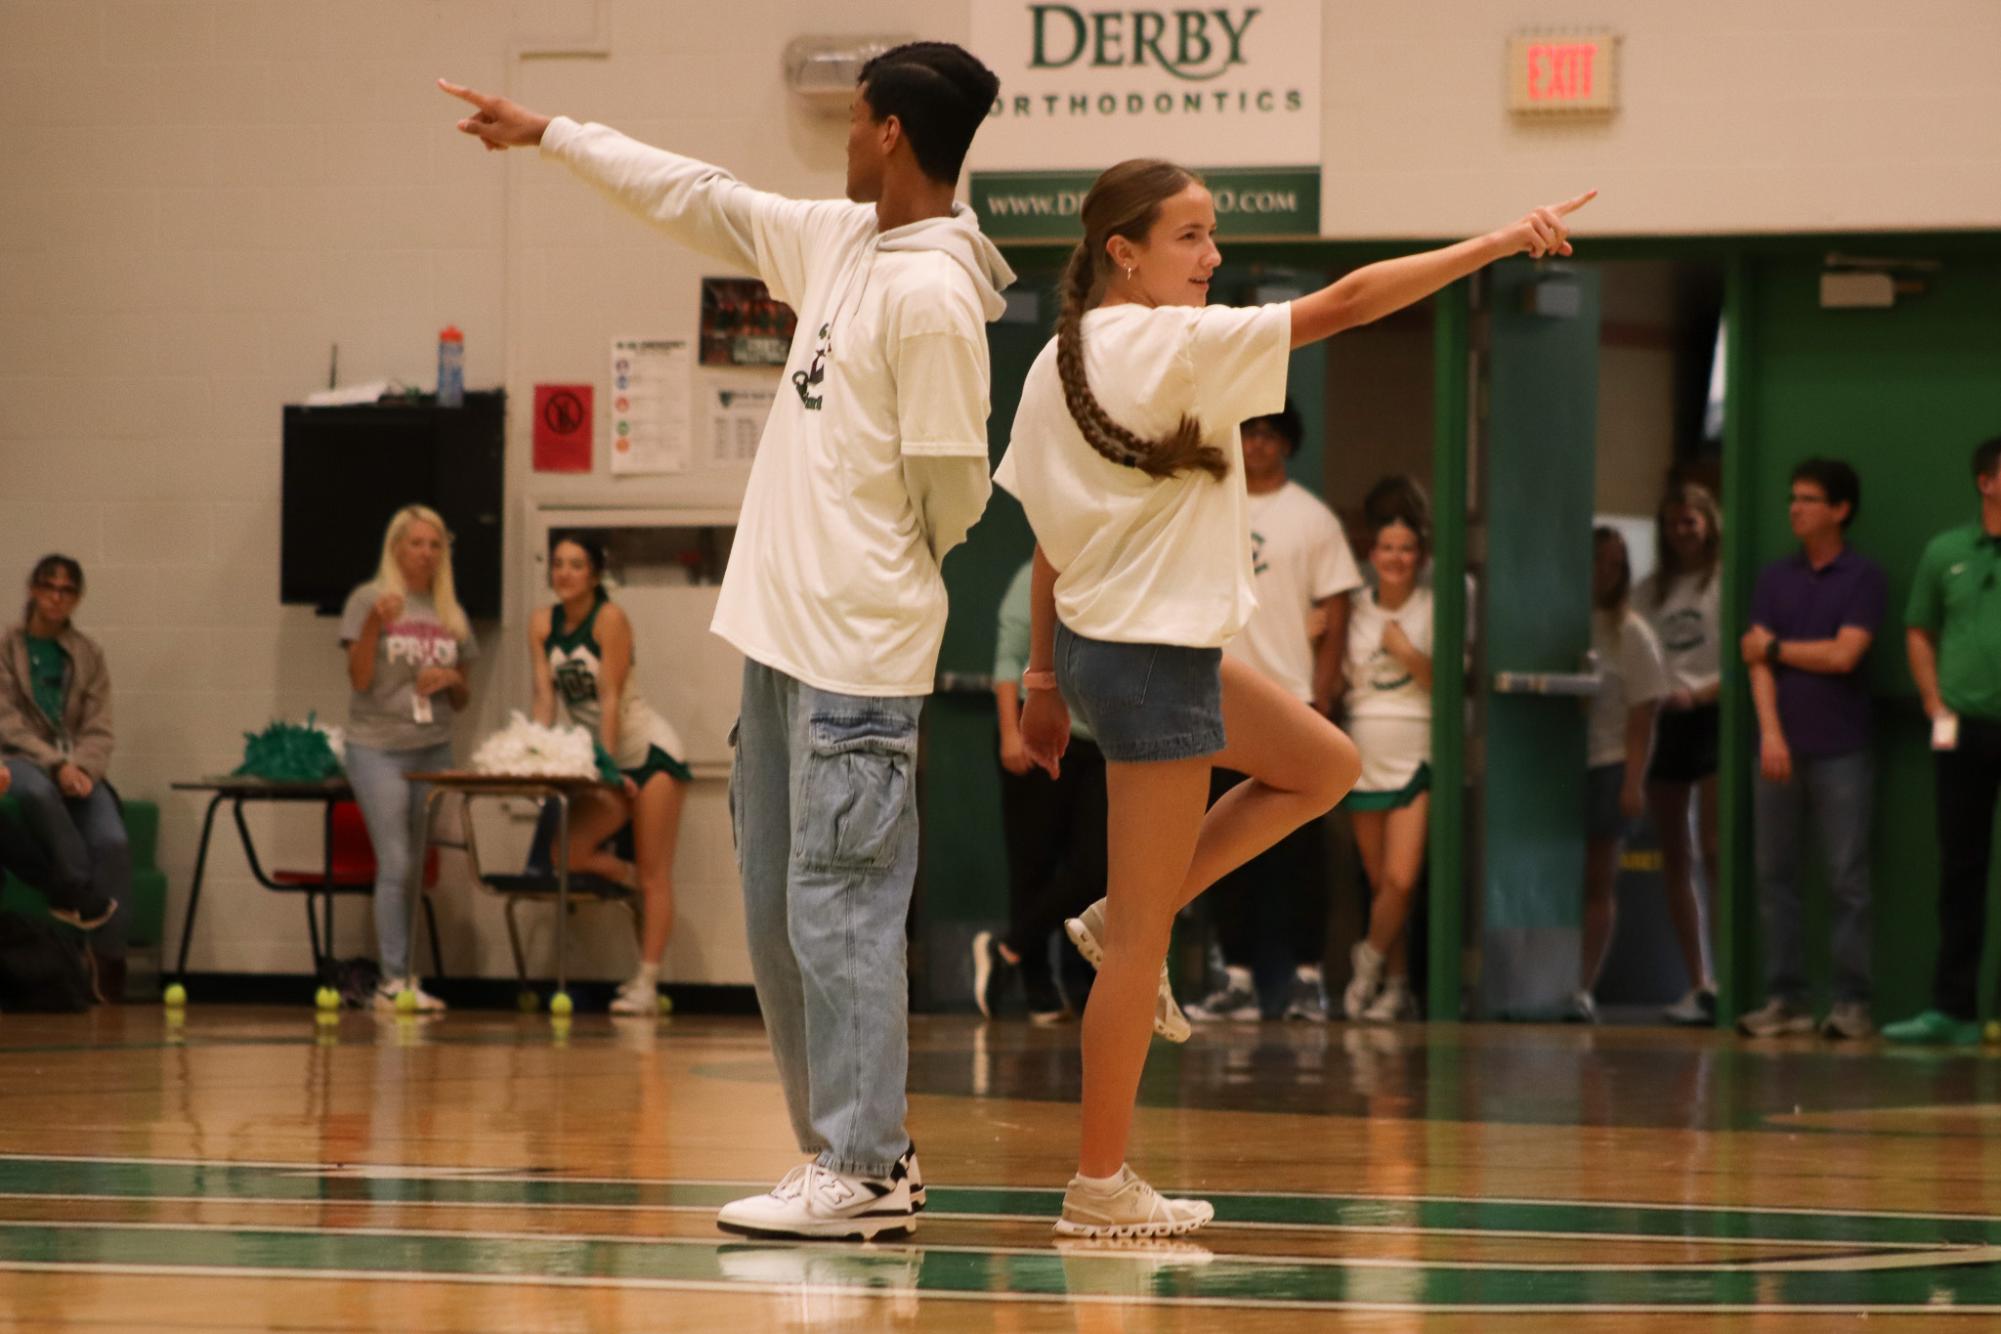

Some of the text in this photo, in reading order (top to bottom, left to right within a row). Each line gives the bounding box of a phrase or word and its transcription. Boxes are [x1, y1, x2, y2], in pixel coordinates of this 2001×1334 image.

[1027, 4, 1261, 80] DERBY
[1526, 43, 1599, 100] EXIT
[988, 91, 1303, 117] ORTHODONTICS
